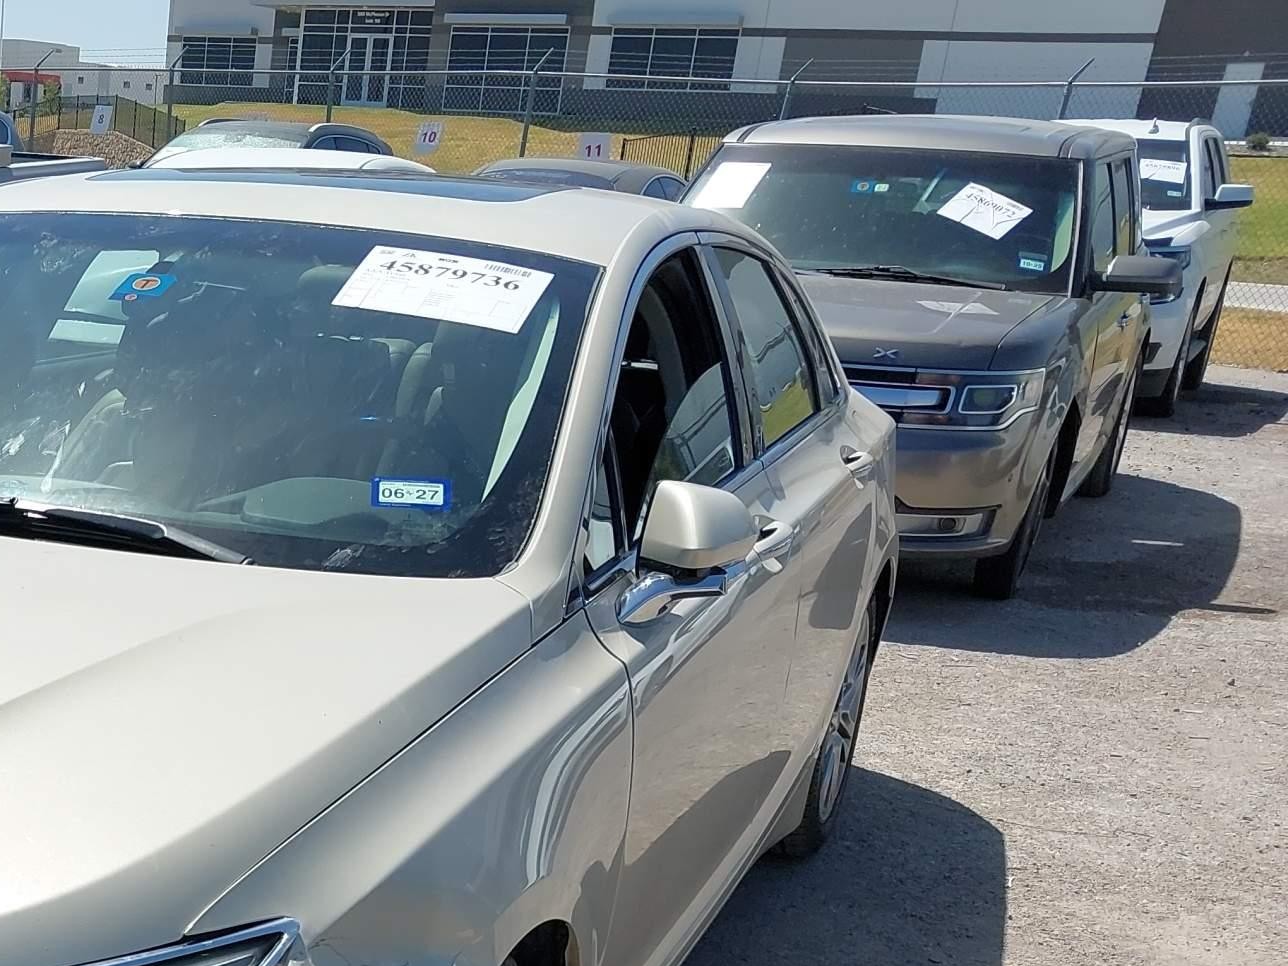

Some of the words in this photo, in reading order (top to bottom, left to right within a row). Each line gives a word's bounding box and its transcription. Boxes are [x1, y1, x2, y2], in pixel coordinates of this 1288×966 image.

[97, 113, 105, 125] 8
[422, 131, 437, 143] 10
[585, 144, 603, 157] 11
[379, 259, 520, 291] 45879736
